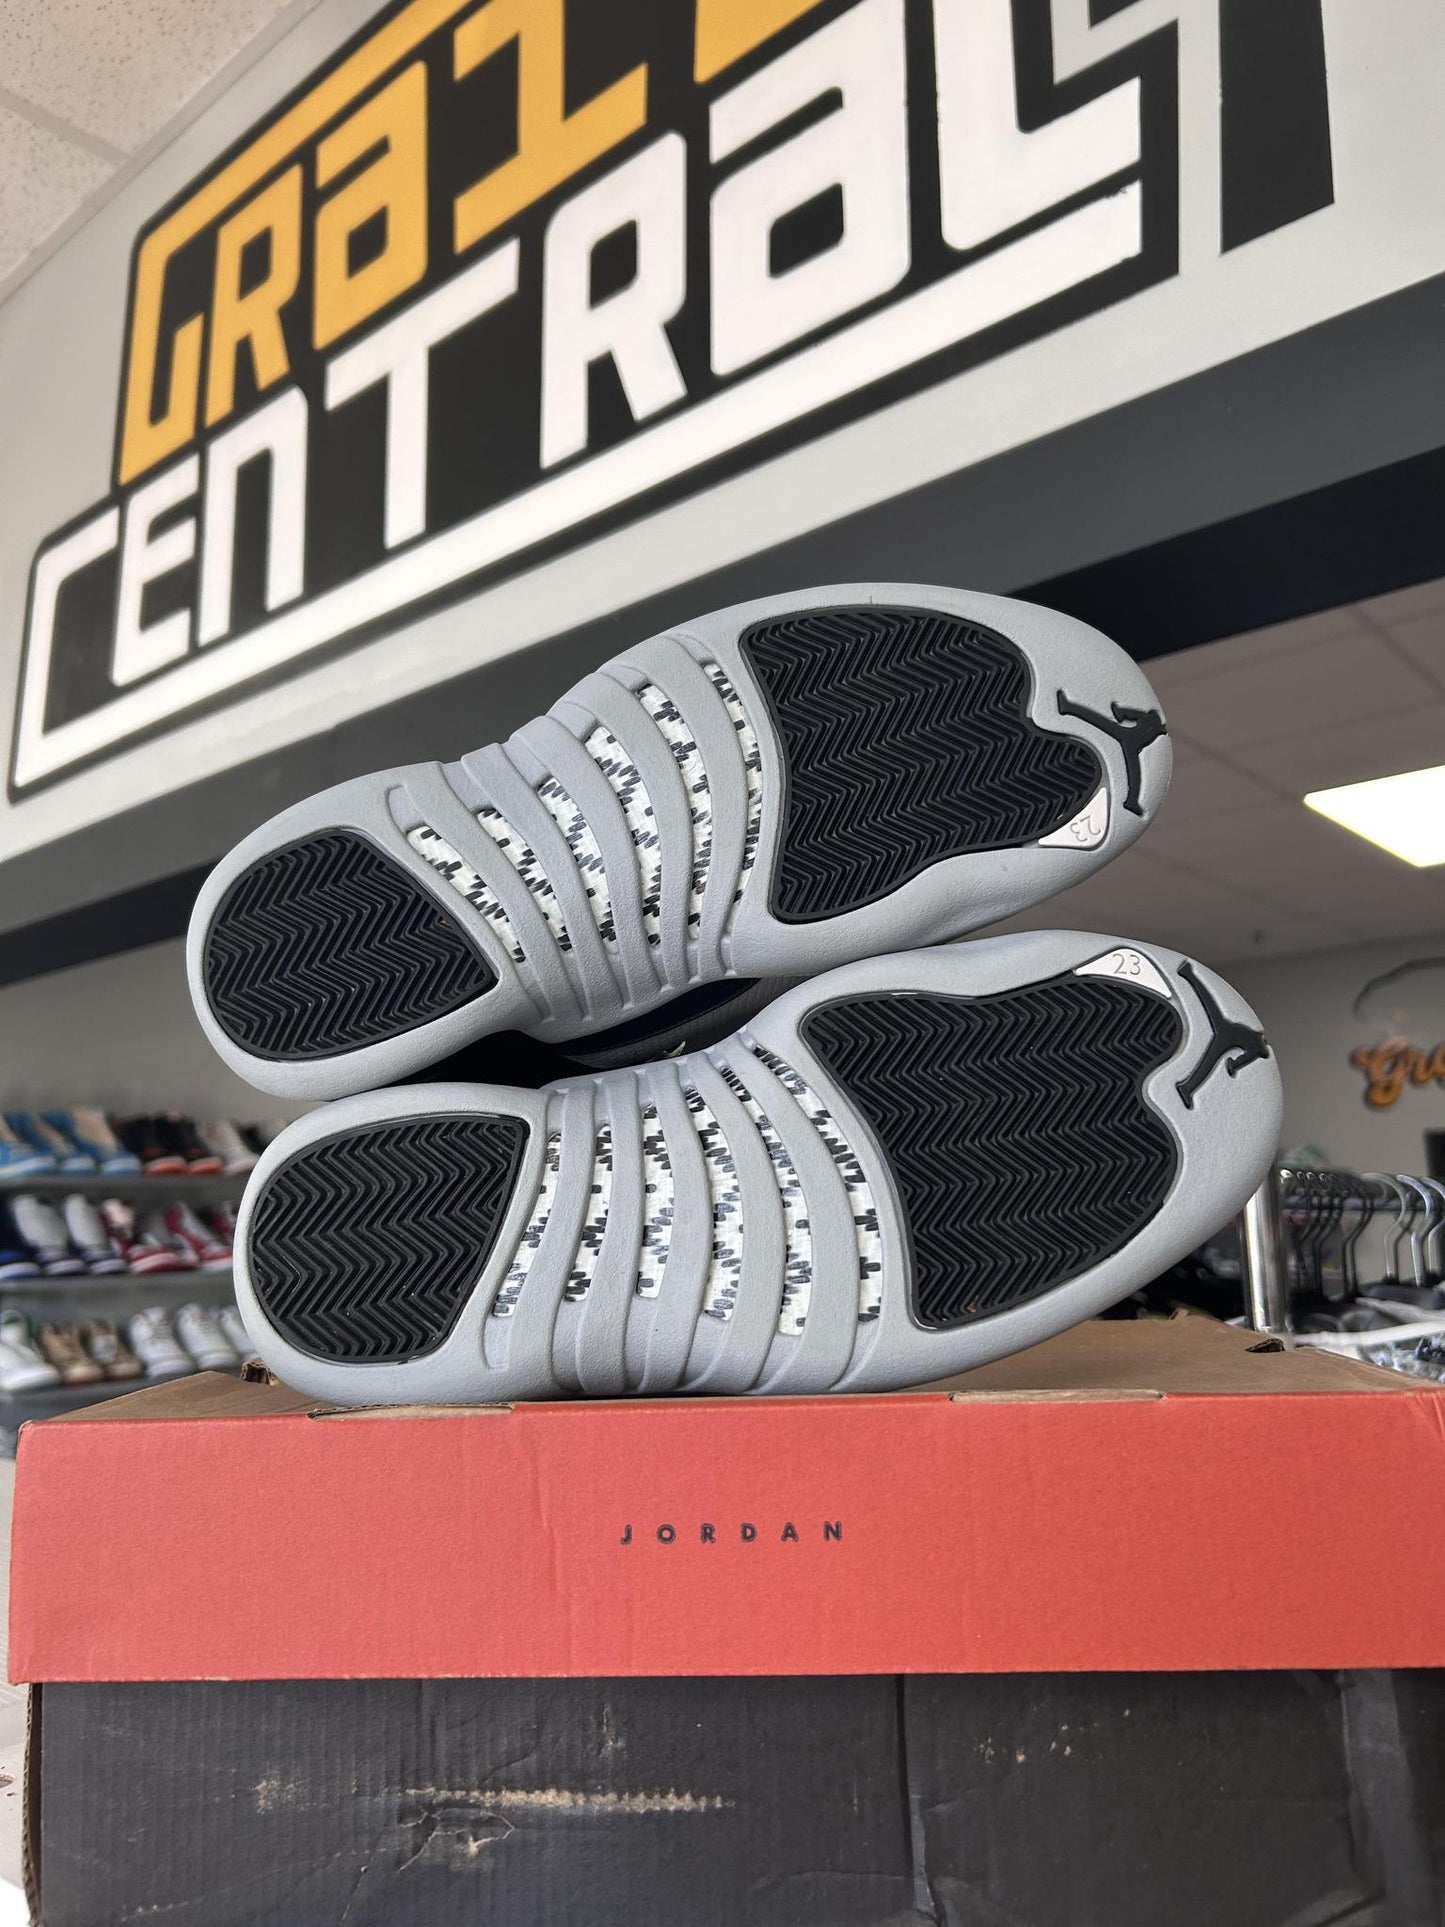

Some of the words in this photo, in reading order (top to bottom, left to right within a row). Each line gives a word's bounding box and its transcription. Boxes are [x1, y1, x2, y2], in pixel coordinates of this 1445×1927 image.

[1069, 814, 1102, 842] 23
[1112, 953, 1142, 976] 23
[620, 1520, 843, 1545] JORDAN
